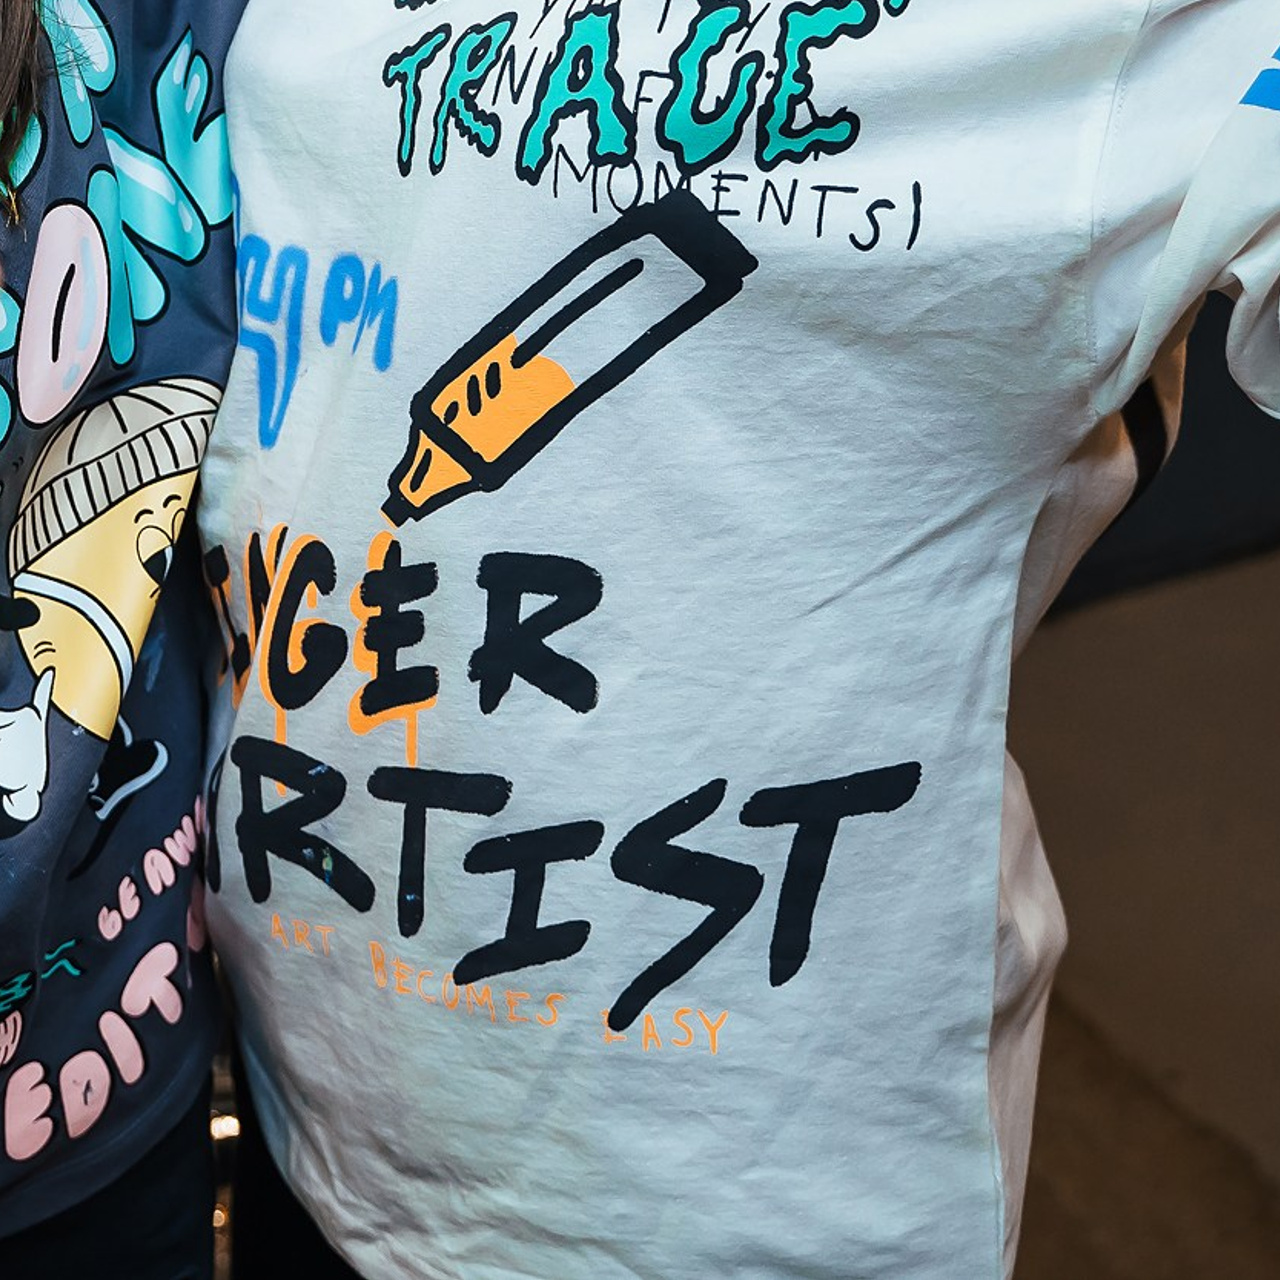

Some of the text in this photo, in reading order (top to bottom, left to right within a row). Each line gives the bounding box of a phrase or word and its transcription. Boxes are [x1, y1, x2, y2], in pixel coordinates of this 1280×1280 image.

[203, 523, 604, 716] INGER
[270, 912, 336, 959] ART
[368, 939, 568, 1026] BECOMES
